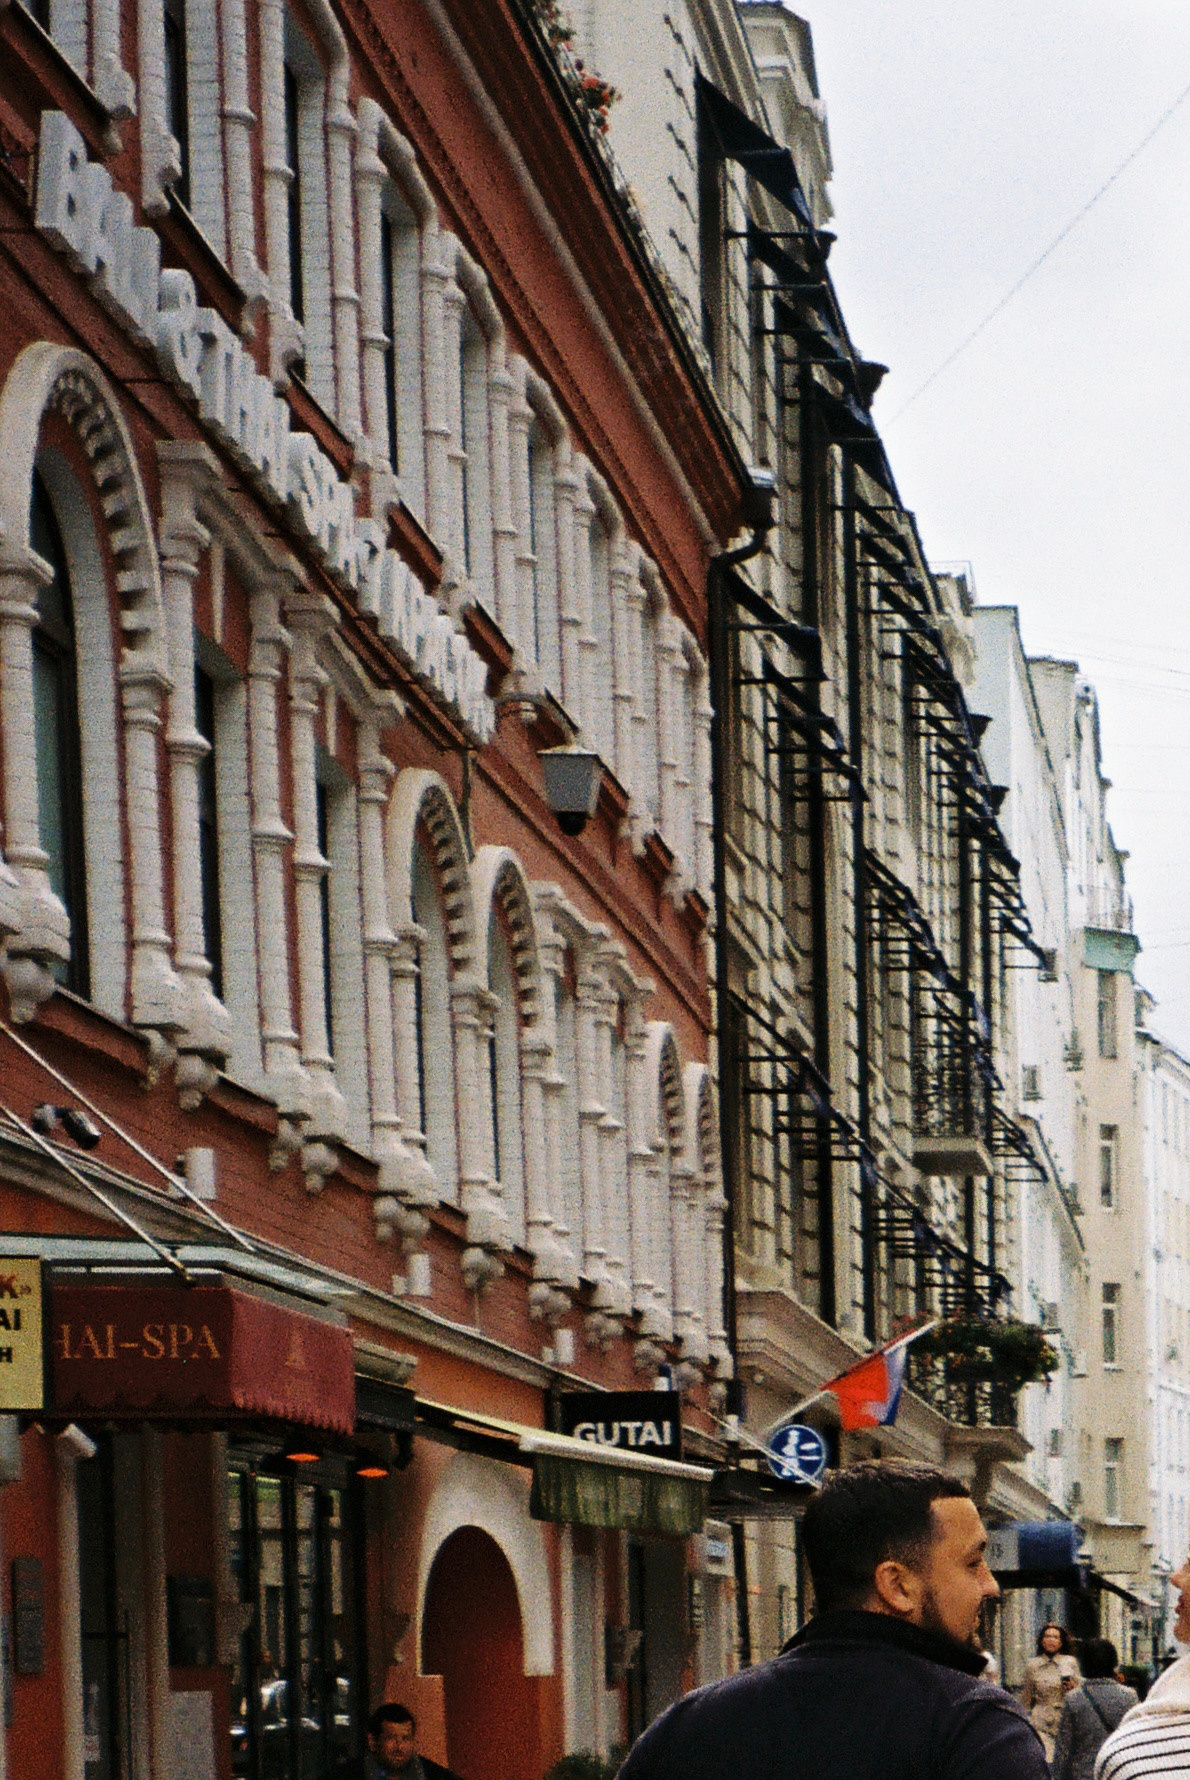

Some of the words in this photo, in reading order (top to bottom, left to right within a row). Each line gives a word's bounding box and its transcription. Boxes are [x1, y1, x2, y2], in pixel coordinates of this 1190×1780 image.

[198, 307, 291, 505] THAI
[287, 432, 357, 590] SPA
[573, 1420, 671, 1447] GUTAI
